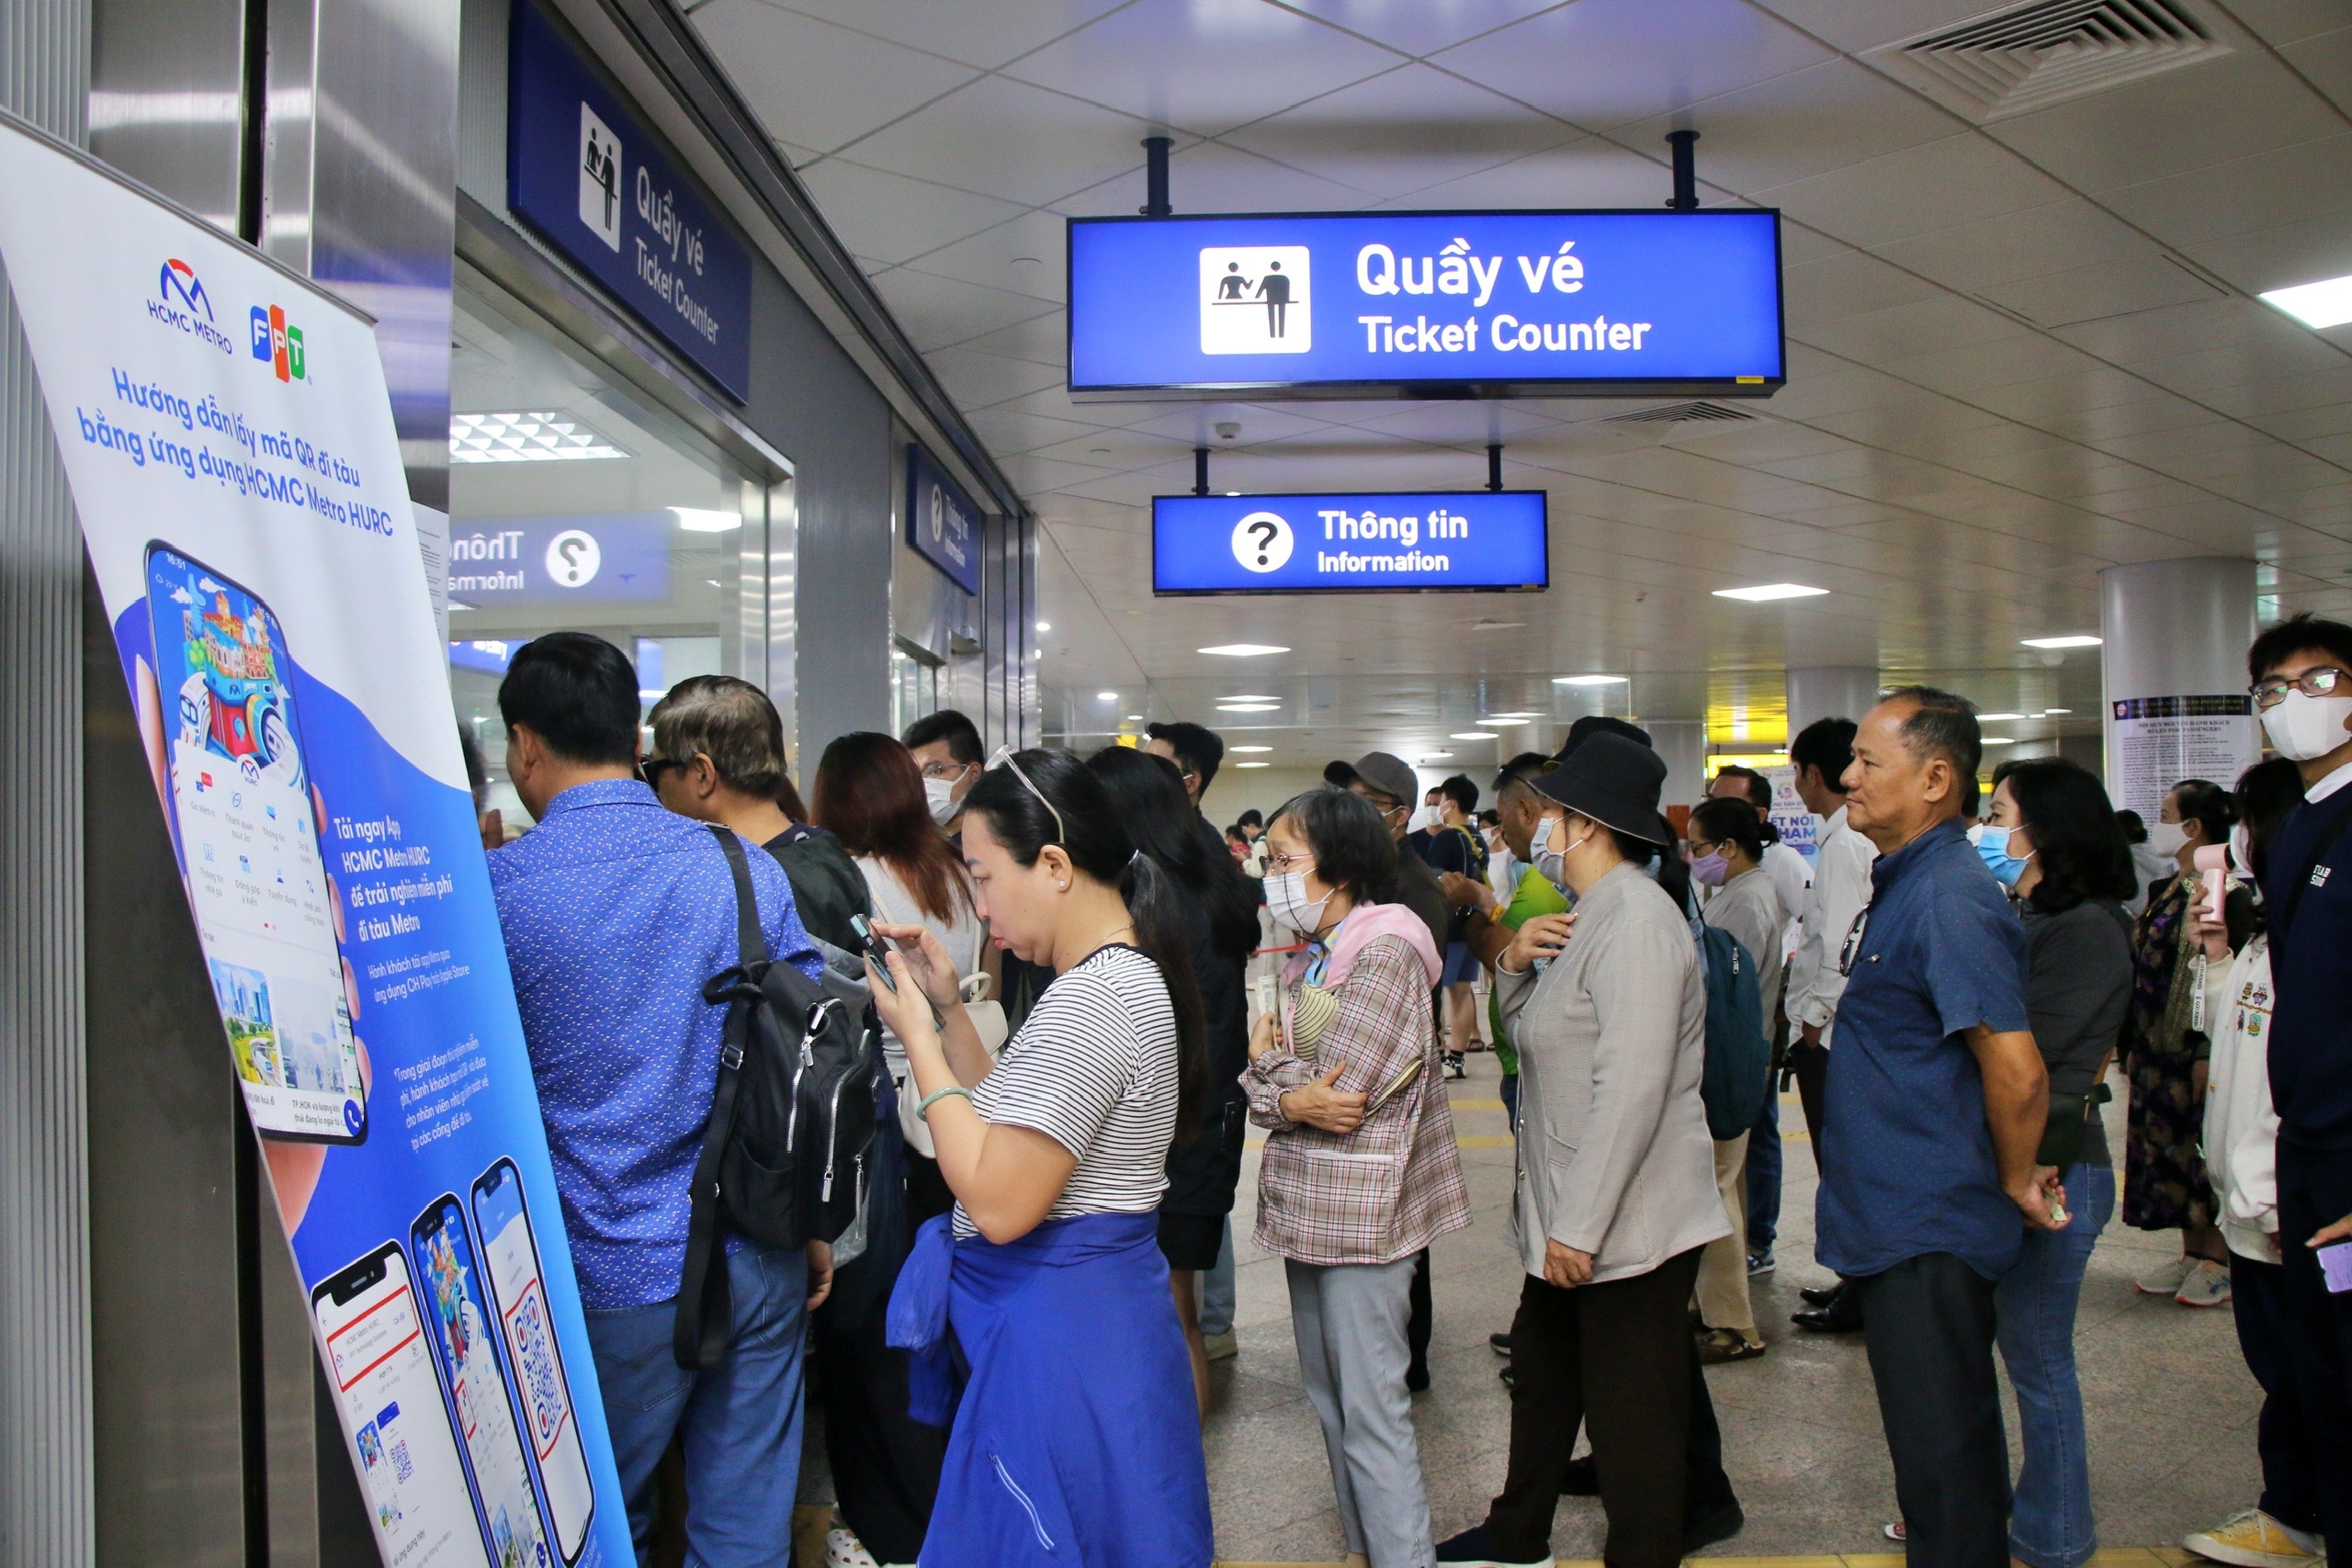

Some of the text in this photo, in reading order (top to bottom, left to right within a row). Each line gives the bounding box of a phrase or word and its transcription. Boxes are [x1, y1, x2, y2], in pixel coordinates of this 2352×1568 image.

[637, 165, 704, 276] Quầy vé
[1357, 238, 1584, 307] Quầy vé
[636, 236, 718, 345] Ticket Counter
[147, 299, 232, 355] HCMC METRO
[253, 310, 304, 373] FPT
[1358, 314, 1652, 354] Ticket Counter
[112, 367, 360, 488] Hướng dẫn lấy mã QR đi tàu
[77, 406, 393, 536] bằng ứng dụng HCMC Metro HURC
[1317, 510, 1468, 547] Thông tin
[165, 553, 187, 570] 16:51
[1317, 551, 1449, 572] Information
[190, 801, 216, 818] Go Metro
[334, 815, 401, 843] Tải ngay App
[342, 846, 431, 874] HCMC Metro HURC
[351, 883, 365, 908] để
[365, 881, 390, 906] trải
[390, 879, 418, 906] nghiệm
[436, 873, 453, 900] phí
[358, 913, 421, 942] đi tàu Metro
[368, 964, 387, 979] Hành
[387, 958, 412, 975] khách
[374, 988, 387, 1004] ứng
[387, 984, 408, 1000] dụng
[407, 977, 421, 992] CH
[420, 974, 433, 990] Play
[451, 964, 470, 978] Store
[416, 1059, 432, 1078] giai
[411, 1084, 429, 1101] hành
[429, 1073, 451, 1092] khách
[406, 1113, 417, 1128] cho
[416, 1105, 435, 1122] nhân
[435, 1099, 450, 1114] viên
[419, 1130, 432, 1145] các
[432, 1122, 451, 1137] cổng
